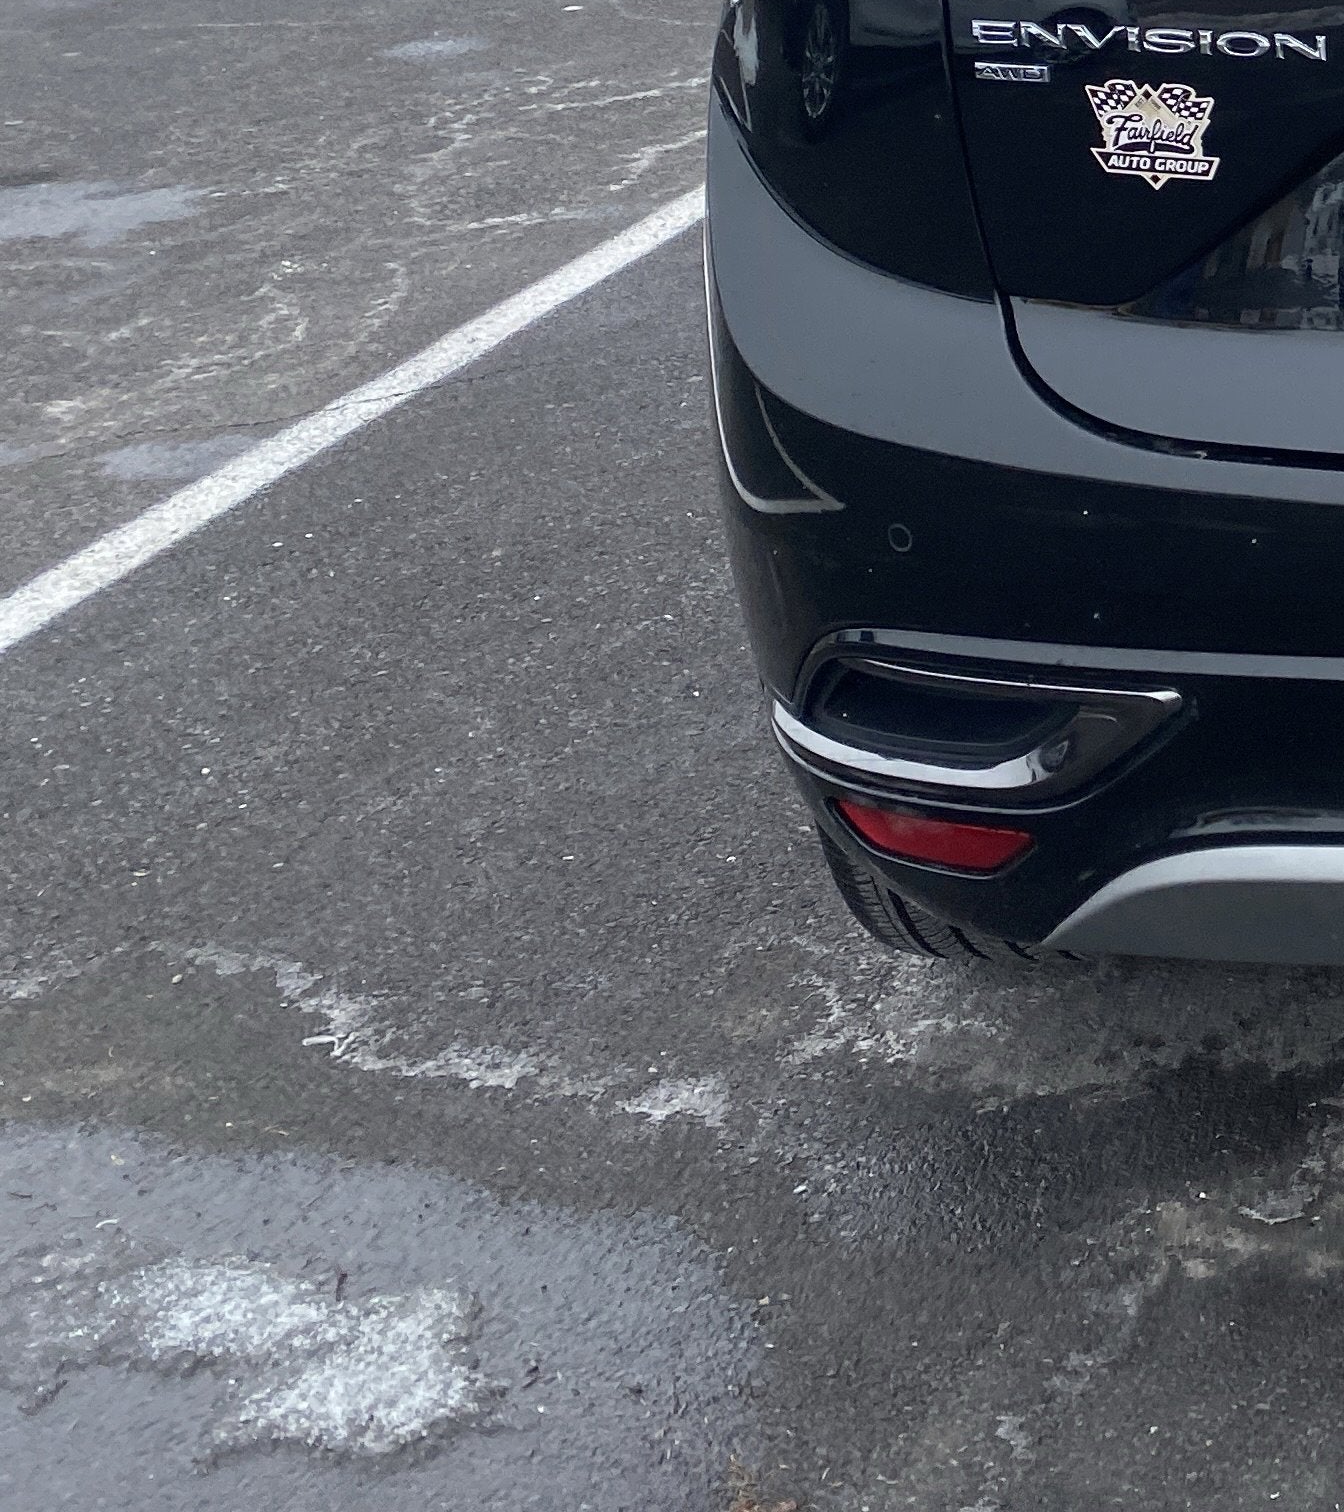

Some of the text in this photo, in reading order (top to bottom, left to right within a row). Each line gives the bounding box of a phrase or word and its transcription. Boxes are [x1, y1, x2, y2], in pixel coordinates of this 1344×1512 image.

[971, 19, 1328, 61] ENVISION
[975, 63, 1051, 83] AWD
[1105, 113, 1200, 154] Fairfield
[1107, 154, 1210, 174] AUTO GROUP
